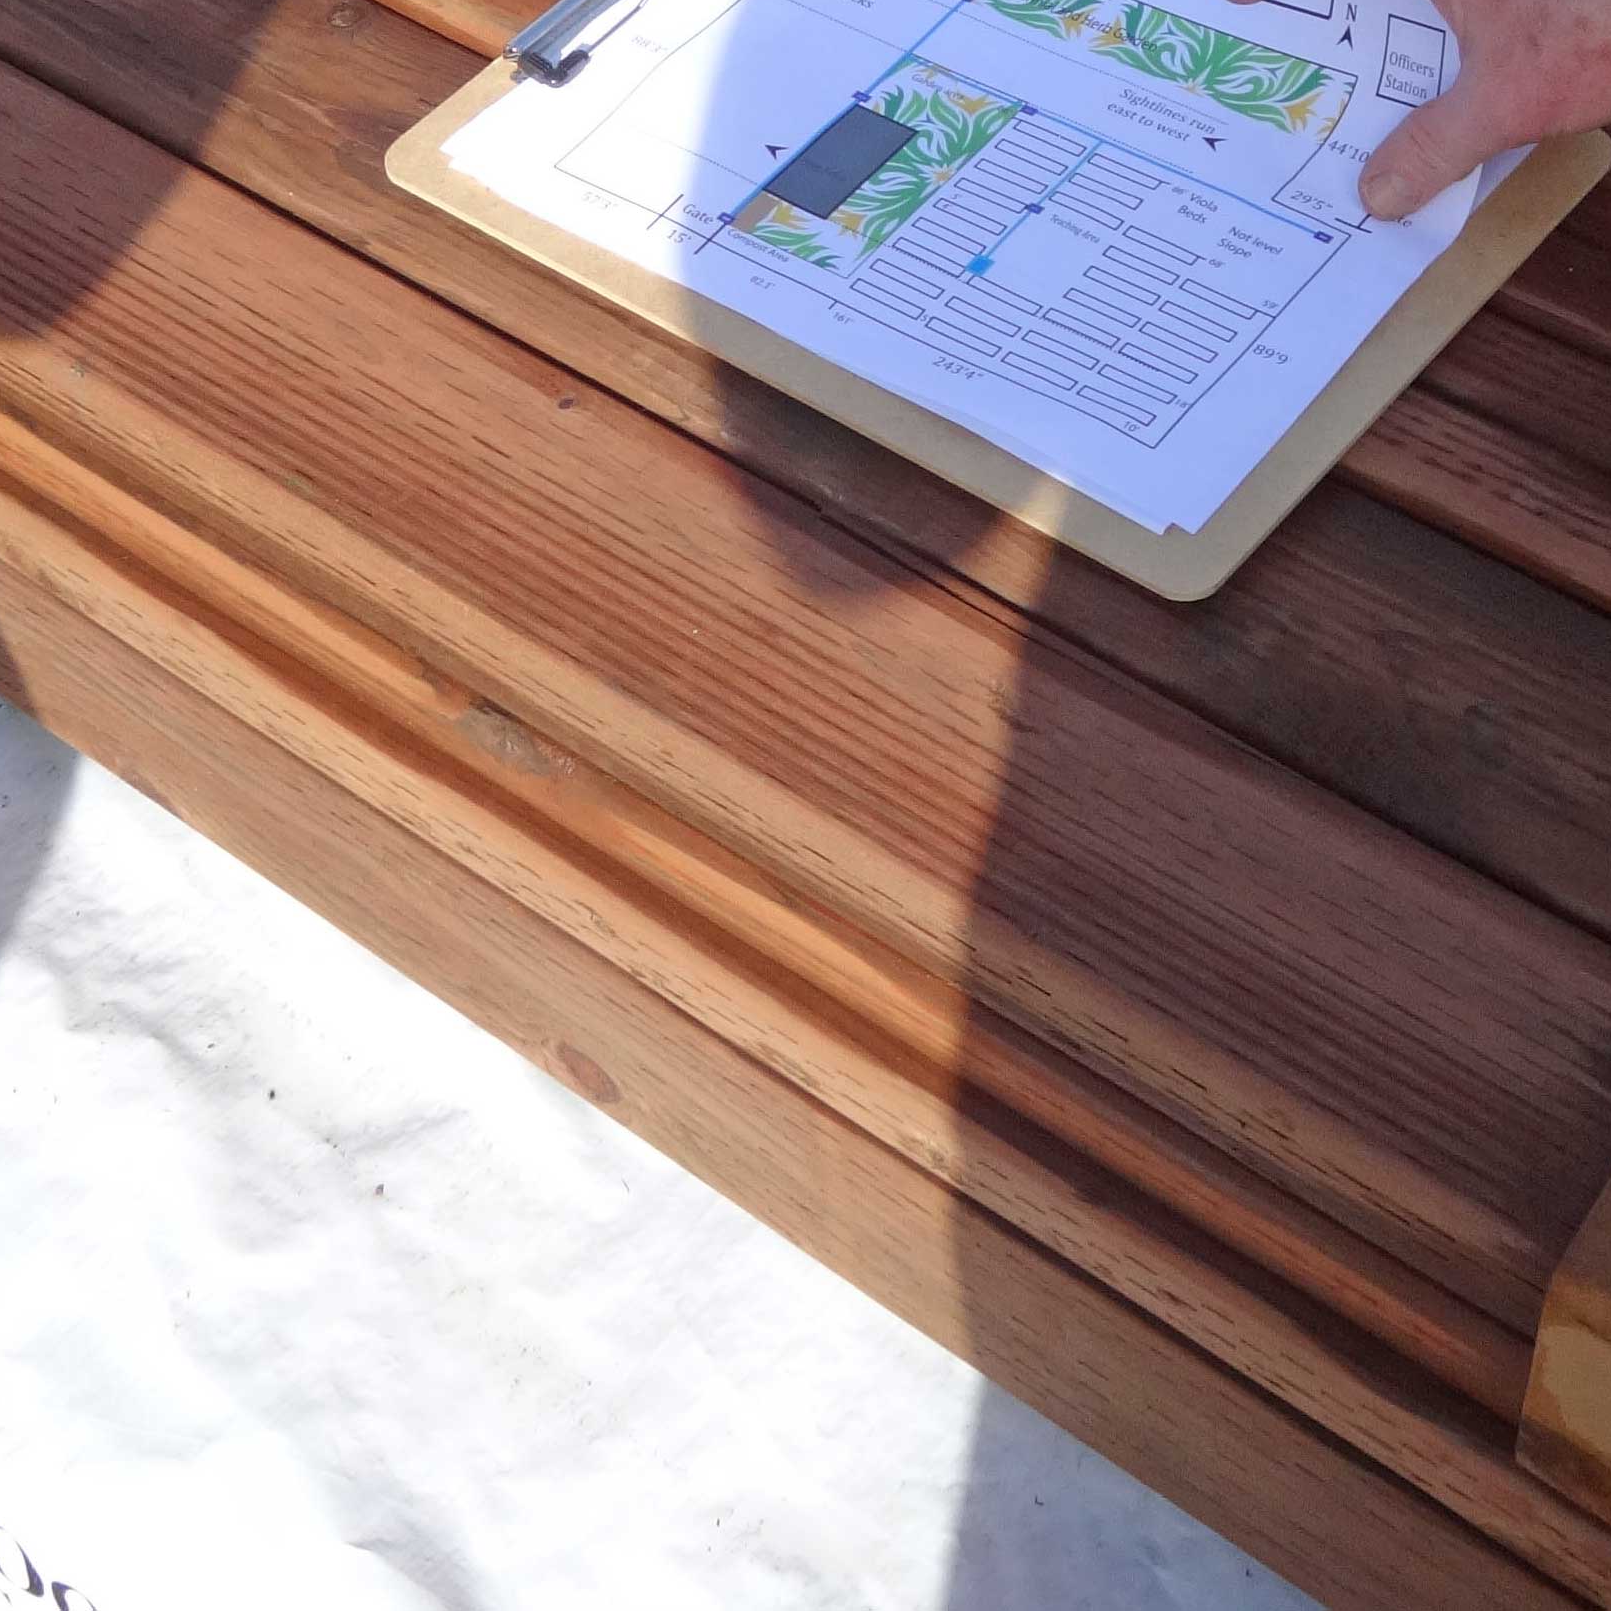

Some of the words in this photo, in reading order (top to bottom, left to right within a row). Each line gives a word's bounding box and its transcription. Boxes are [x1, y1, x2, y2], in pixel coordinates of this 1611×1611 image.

[1345, 2, 1358, 22] N
[1081, 11, 1112, 35] Herb
[1113, 26, 1158, 53] Garden
[1388, 50, 1436, 79] Officers
[1383, 73, 1429, 100] Station
[1106, 102, 1137, 123] east
[1138, 113, 1155, 130] to
[1155, 121, 1190, 143] west
[1118, 88, 1188, 128] Sightlines
[1188, 119, 1217, 136] run
[682, 203, 715, 225] Gate
[1176, 204, 1209, 225] Beds
[1189, 192, 1219, 213] Viola
[726, 229, 770, 257] Compost
[769, 247, 790, 264] Area
[1217, 237, 1252, 259] Slope
[1228, 226, 1251, 244] Not
[1251, 236, 1284, 255] level
